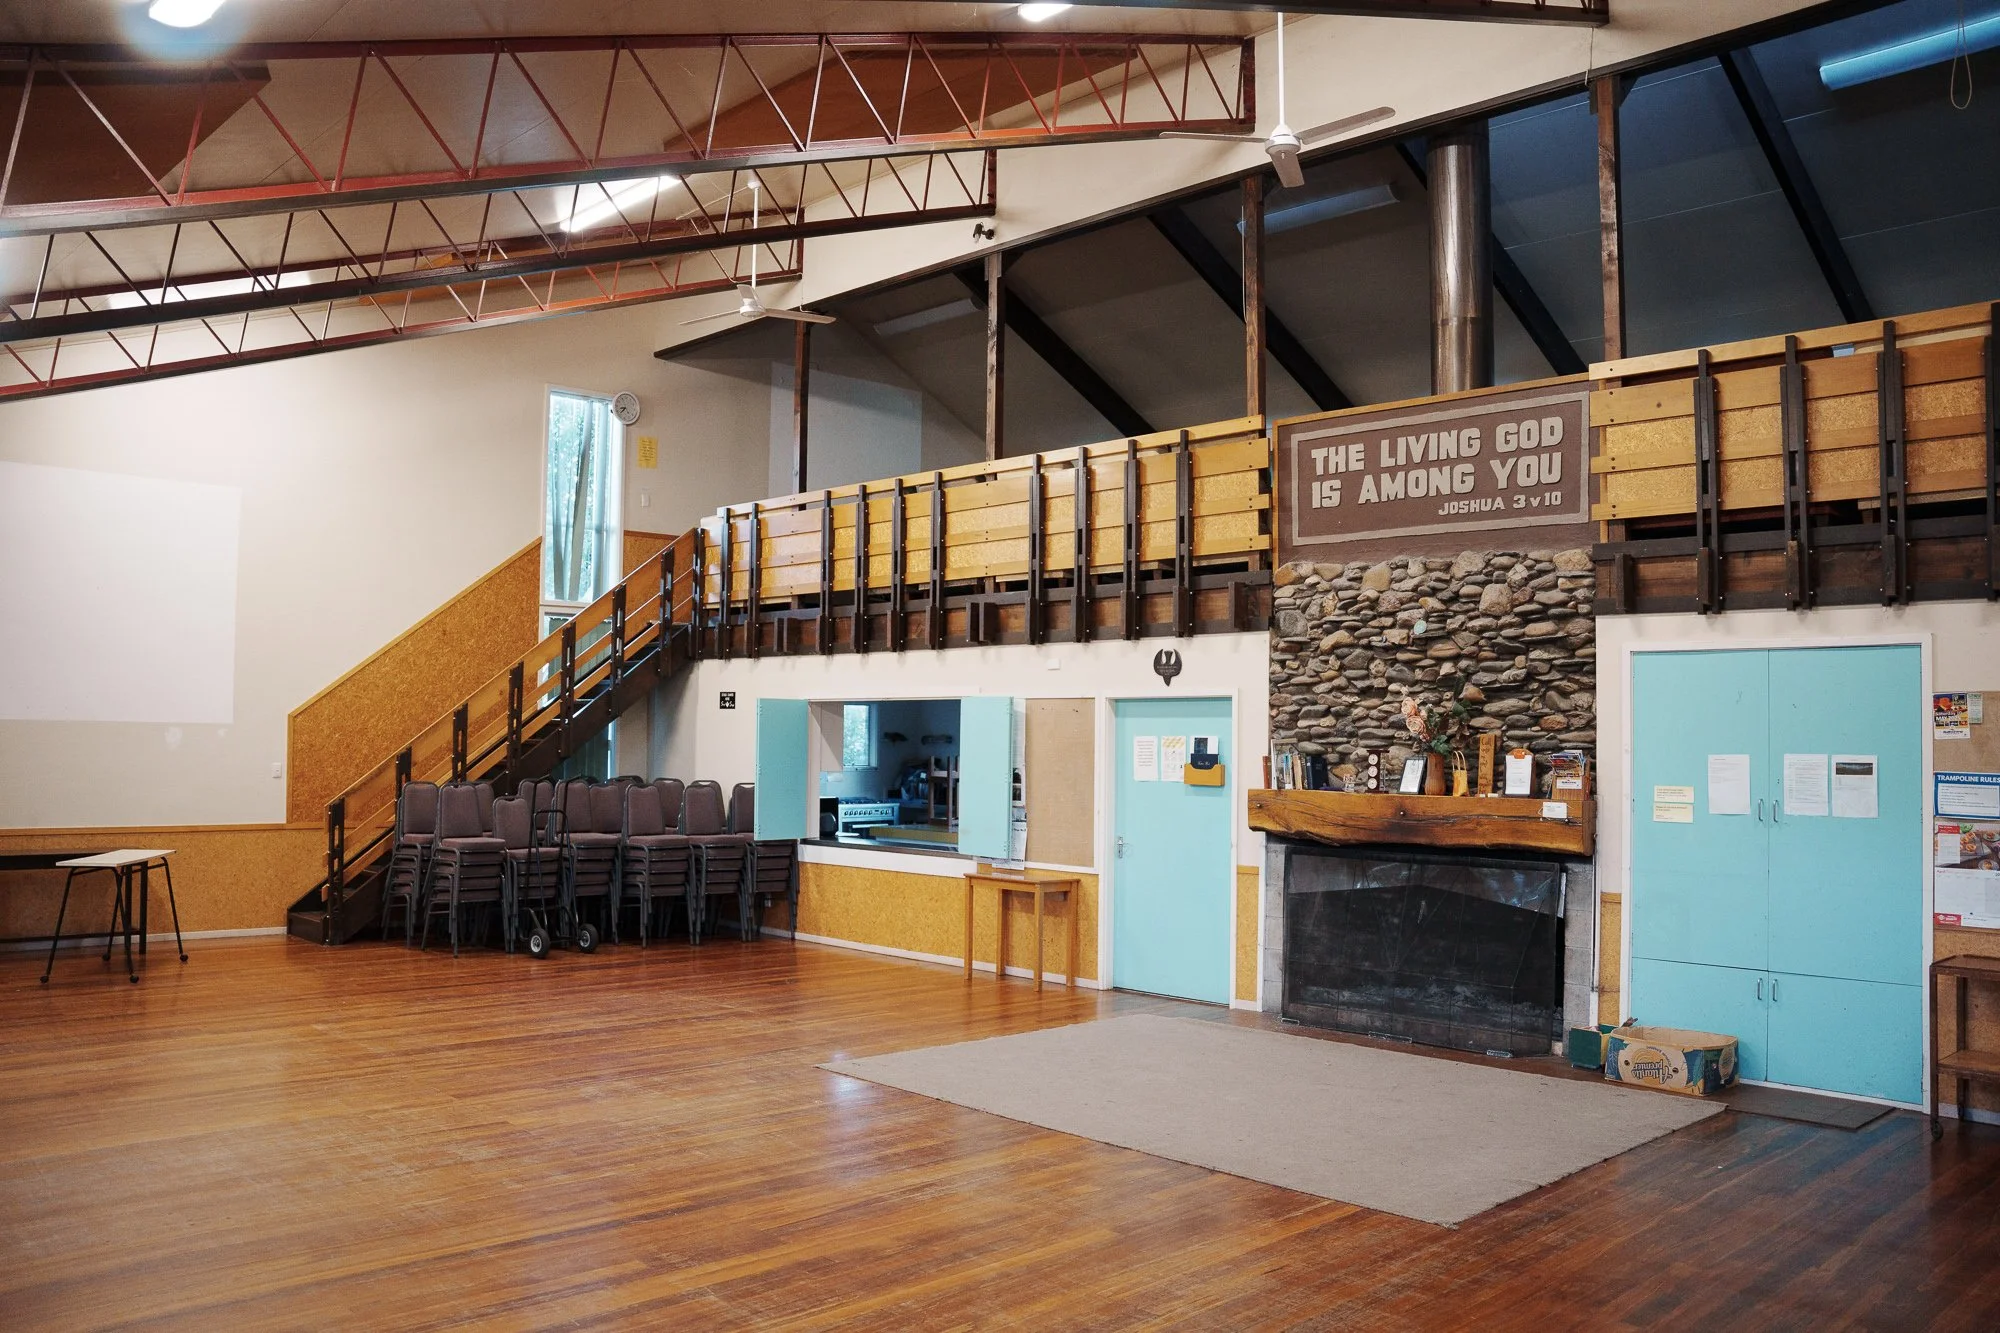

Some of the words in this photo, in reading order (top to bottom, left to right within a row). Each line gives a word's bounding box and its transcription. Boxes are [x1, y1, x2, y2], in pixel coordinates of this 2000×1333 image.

[1311, 443, 1365, 476] THE
[1380, 427, 1481, 468] LIVING
[1495, 416, 1564, 453] GOD
[1311, 479, 1342, 509] IS
[1358, 463, 1475, 505] AMONG
[1490, 451, 1562, 490] YOU
[1438, 496, 1506, 516] JOSHUA
[1513, 494, 1525, 509] 3
[1543, 491, 1562, 507] 10
[1937, 774, 1979, 783] TRAMPOLINE
